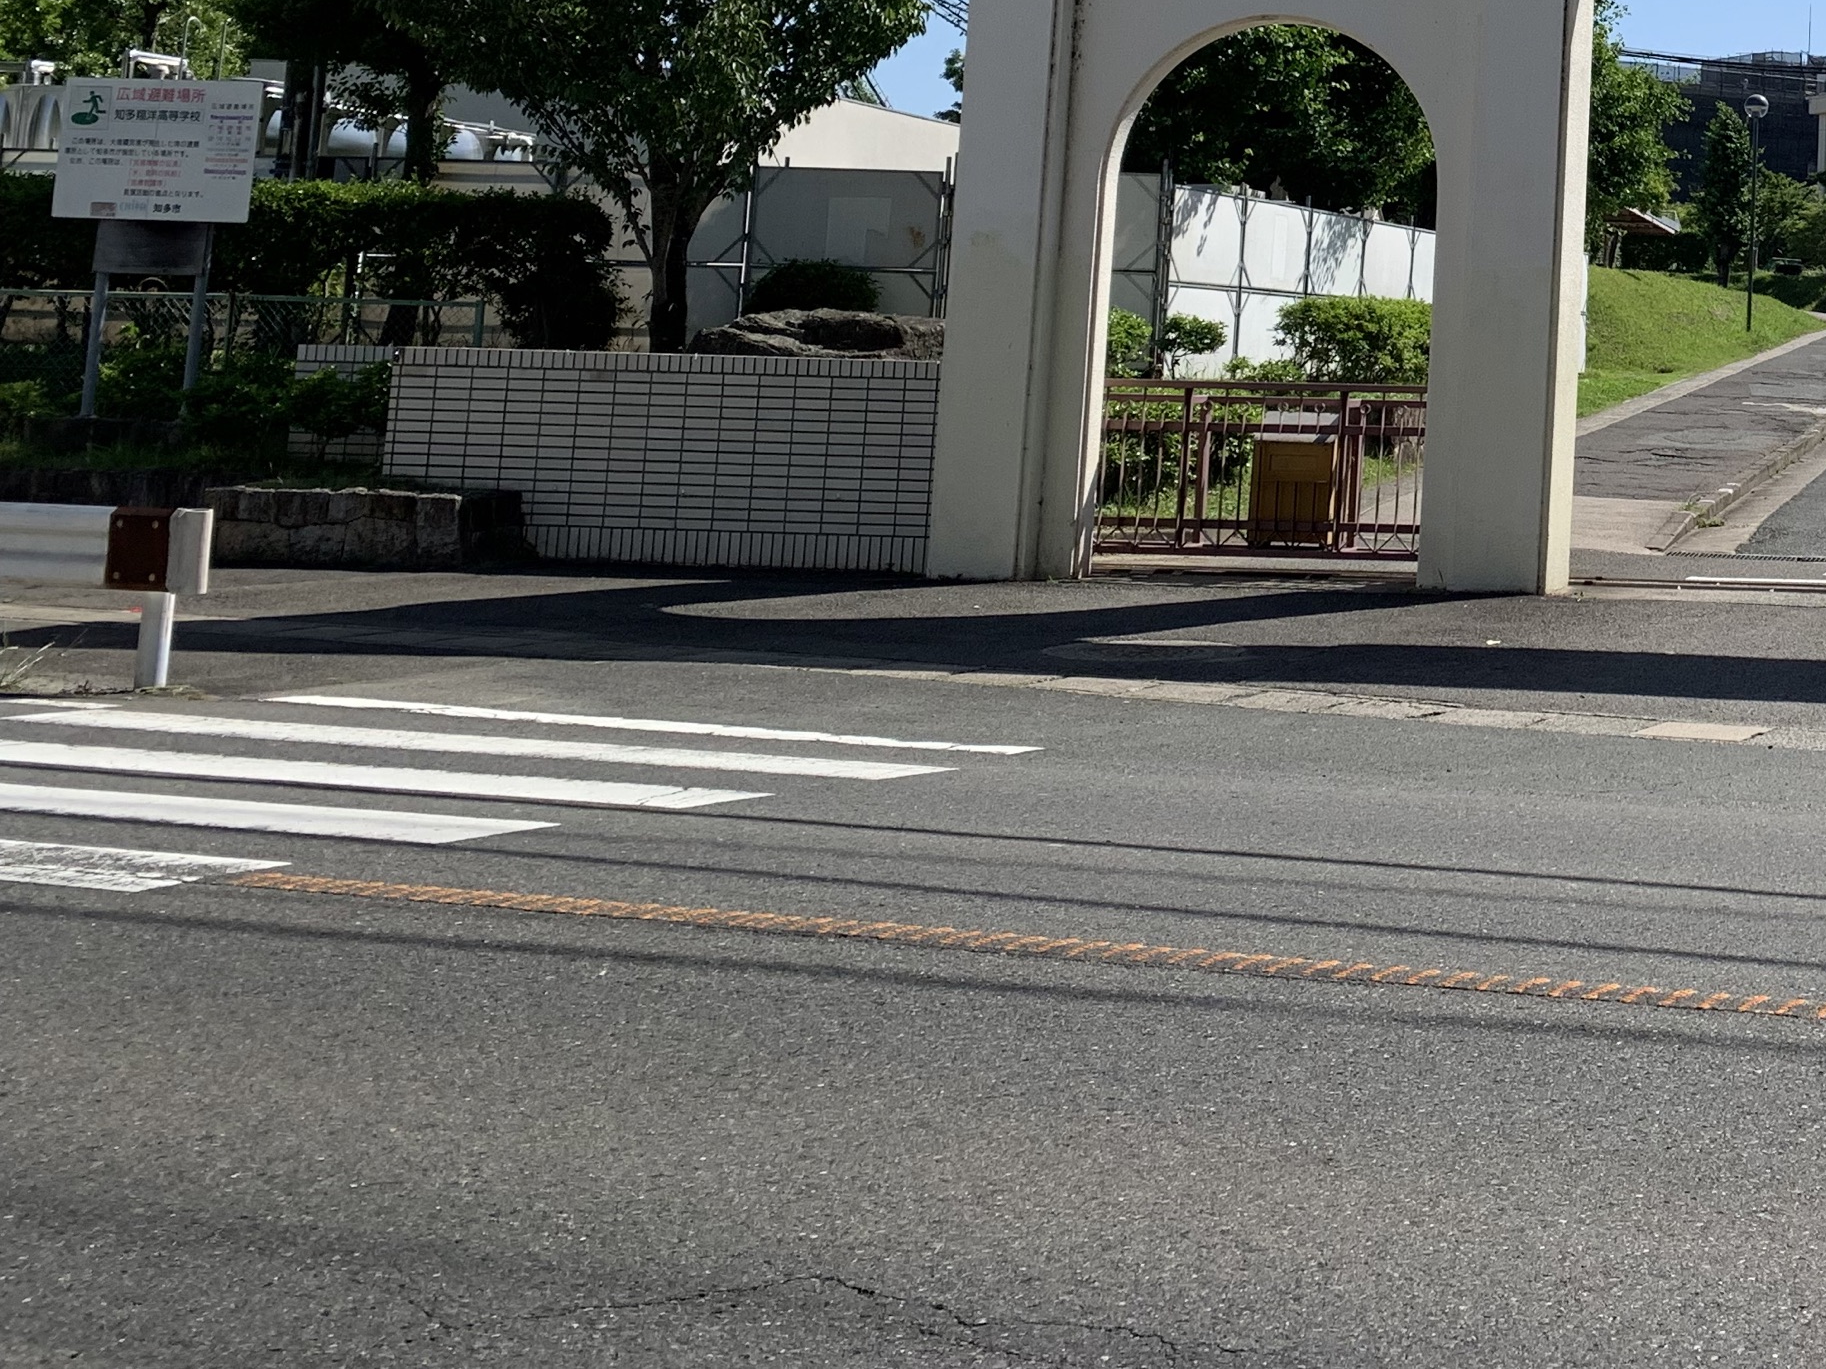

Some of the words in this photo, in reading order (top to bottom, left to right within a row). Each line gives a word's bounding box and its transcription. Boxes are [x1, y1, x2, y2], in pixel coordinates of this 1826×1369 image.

[115, 86, 207, 104] 広域避難場所
[152, 203, 182, 214] 知多市
